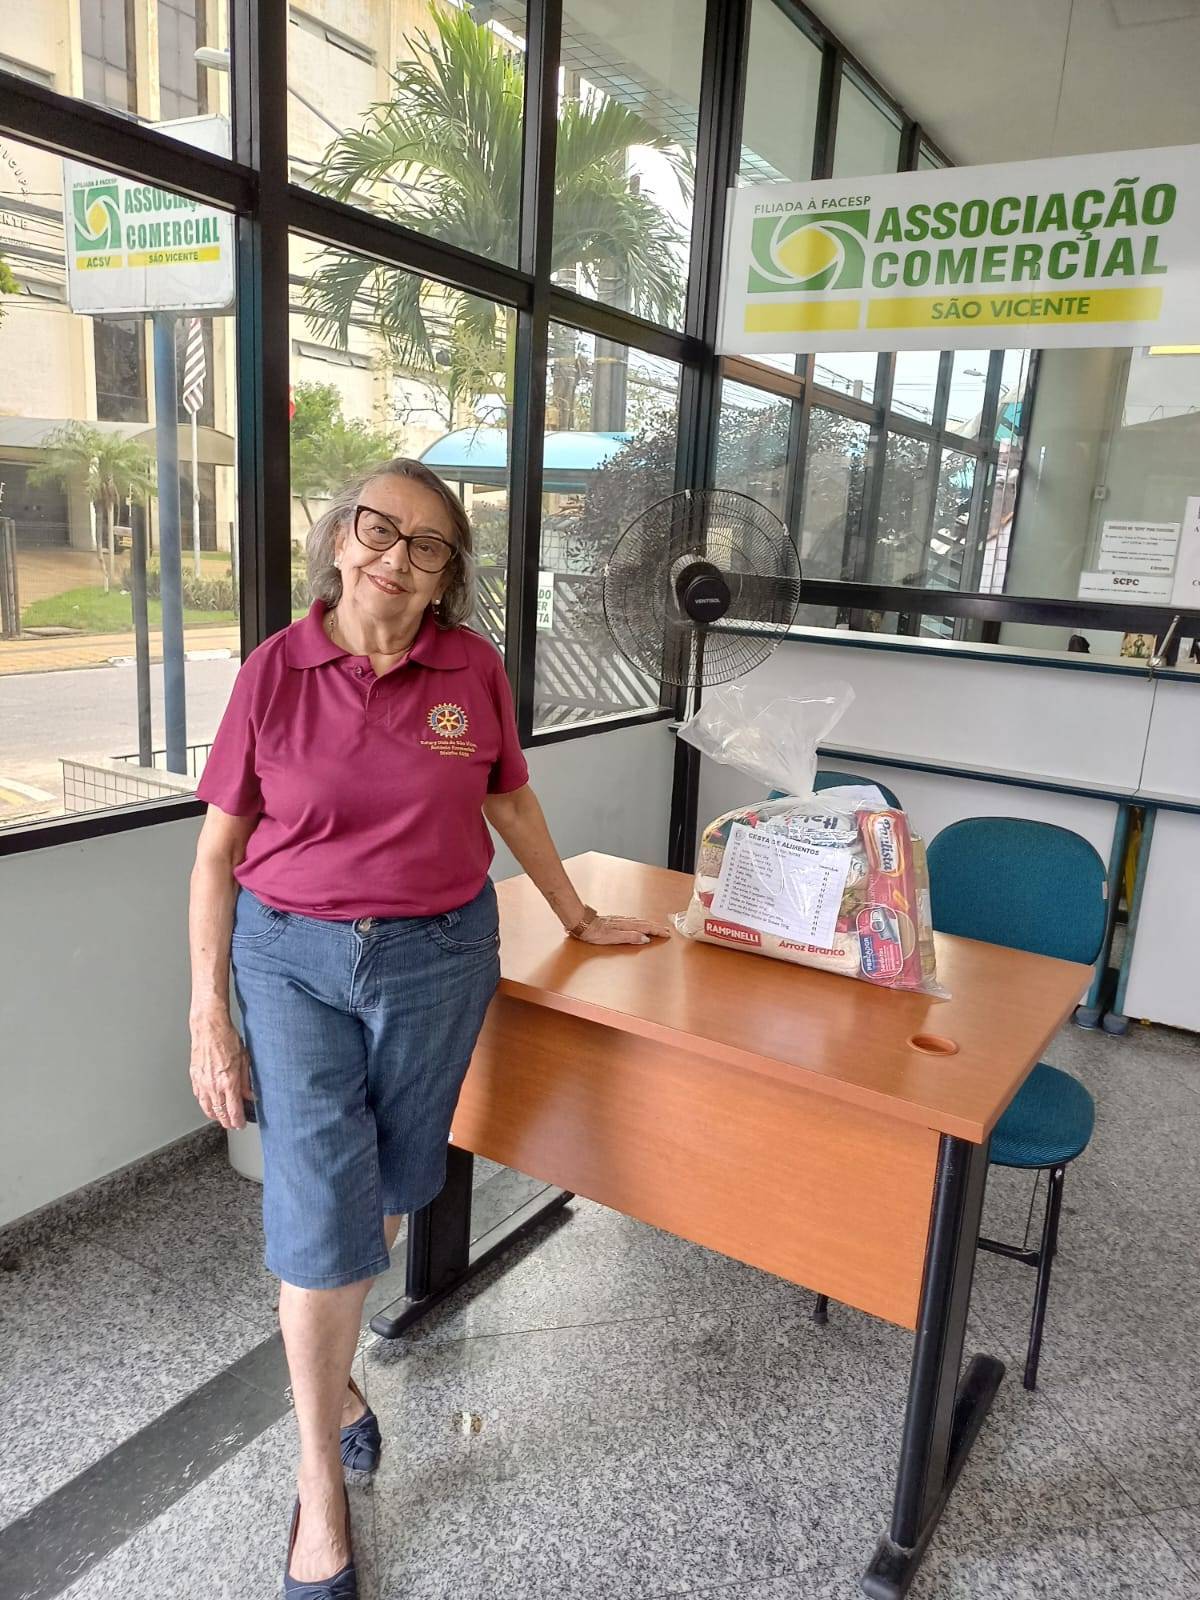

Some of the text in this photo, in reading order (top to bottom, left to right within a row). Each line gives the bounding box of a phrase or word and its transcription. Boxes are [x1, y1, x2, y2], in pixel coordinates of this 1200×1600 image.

[124, 186, 201, 214] ASSOCI
[754, 195, 872, 214] FILIADA À FACESP
[874, 177, 1178, 243] ASSOCIAÇÃO
[126, 216, 220, 250] COMERCIAL
[86, 256, 111, 268] ACSV
[148, 251, 199, 263] SÃO VICENTE
[871, 235, 1168, 289] COMERCIAL
[931, 296, 1091, 320] SÃO VICENTE
[1113, 577, 1140, 586] SCPC
[748, 832, 770, 844] CESTA
[781, 841, 820, 856] ALIMENTOS
[706, 922, 759, 943] RAMPINELLI
[778, 940, 846, 957] Arroz Branco
